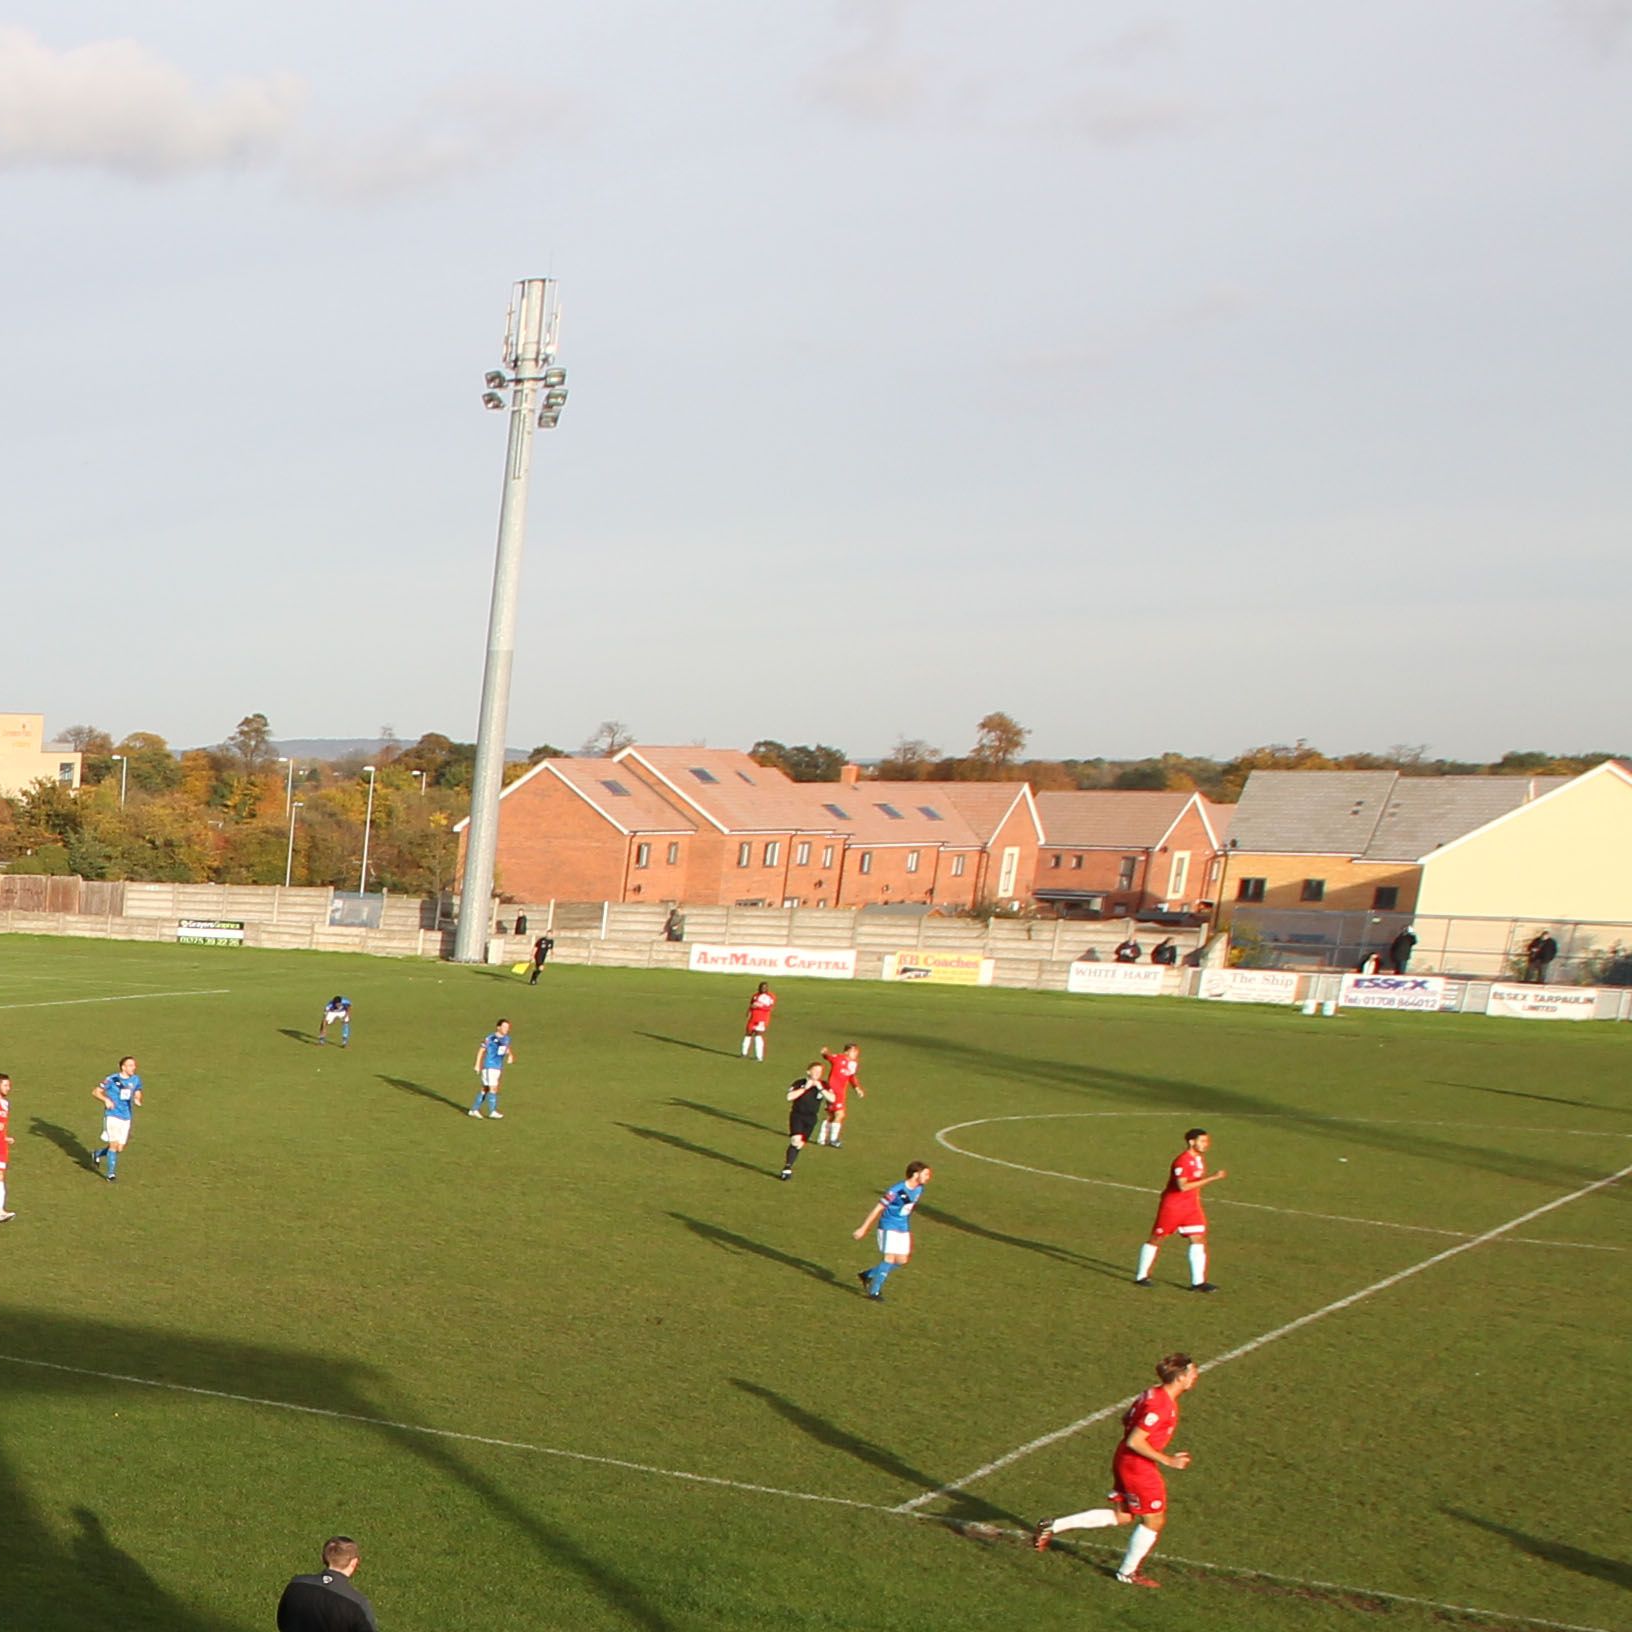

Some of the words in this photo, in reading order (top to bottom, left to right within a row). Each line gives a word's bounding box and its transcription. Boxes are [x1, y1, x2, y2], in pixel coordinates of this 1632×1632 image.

[1075, 967, 1117, 979] WHITE
[1123, 970, 1161, 981] HART
[1232, 972, 1256, 984] The
[1262, 975, 1294, 989] Ship
[1353, 978, 1428, 990] ESSEX
[1492, 991, 1527, 1001] ESSEX
